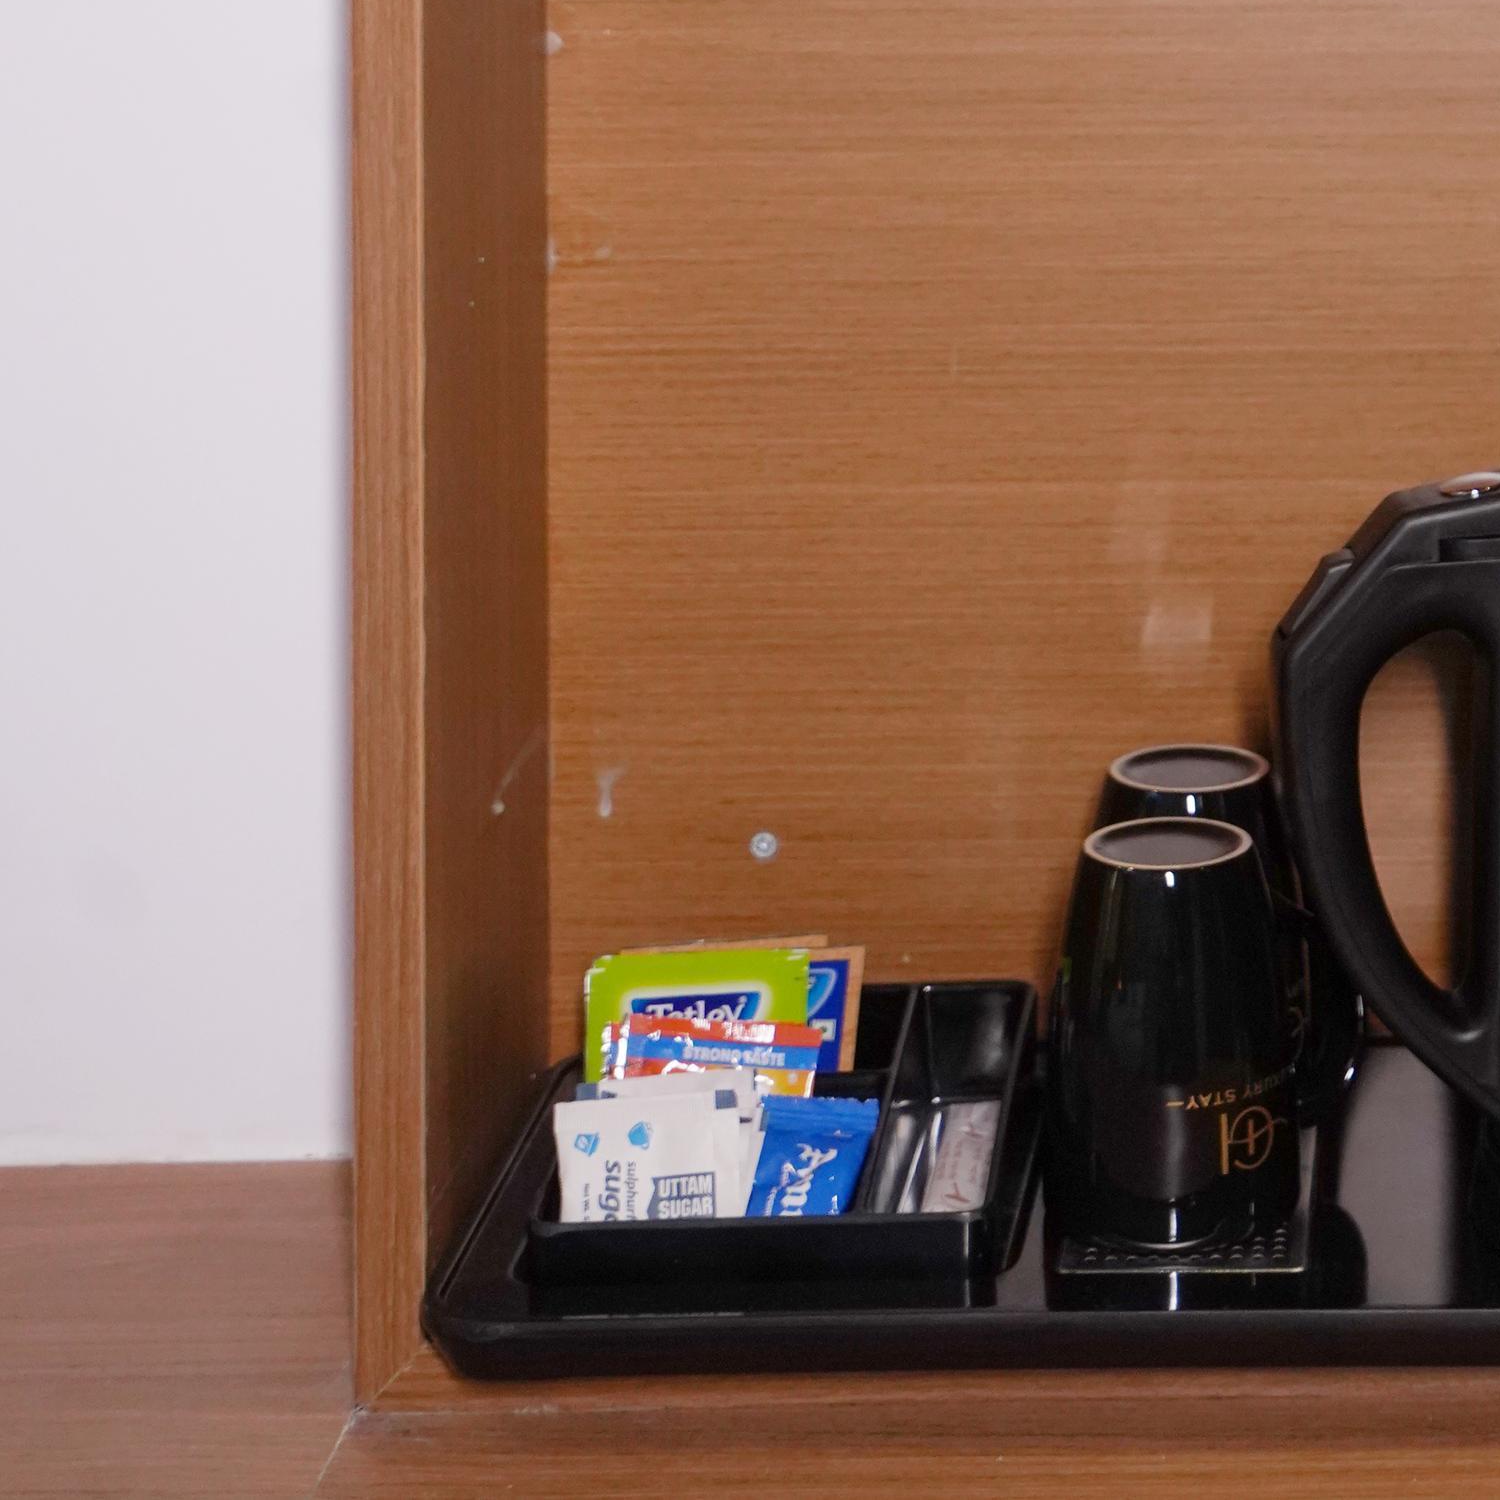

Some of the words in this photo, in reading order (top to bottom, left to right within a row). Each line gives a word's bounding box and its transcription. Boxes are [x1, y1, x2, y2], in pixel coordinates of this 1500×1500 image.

[1185, 1089, 1236, 1110] STAY
[658, 1174, 713, 1198] UTTAM
[657, 1197, 712, 1219] SUGAR
